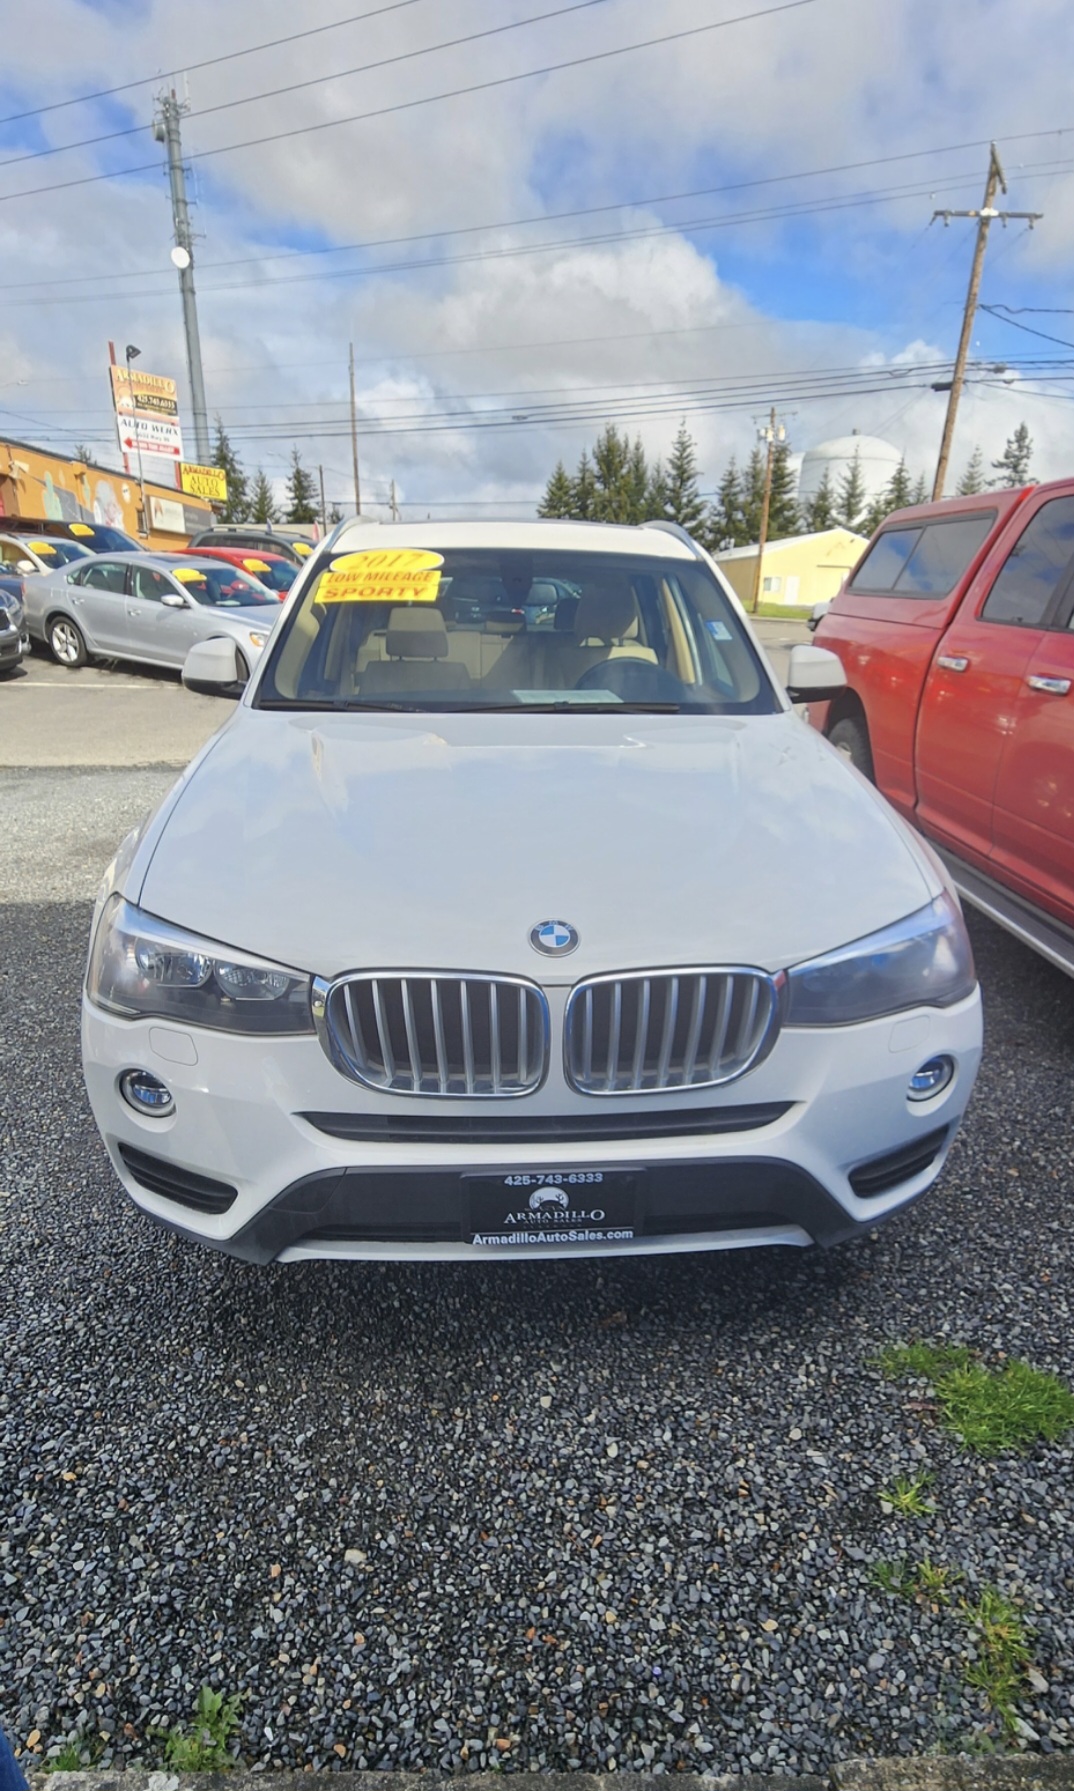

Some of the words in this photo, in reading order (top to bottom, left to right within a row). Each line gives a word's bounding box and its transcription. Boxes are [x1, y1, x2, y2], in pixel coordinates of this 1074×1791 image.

[182, 464, 225, 481] ARMADILLO
[190, 475, 218, 489] AUTO
[190, 484, 221, 498] SALES
[346, 553, 427, 570] 2017
[326, 571, 361, 583] LOW
[364, 570, 433, 583] MILEAGE
[322, 585, 428, 599] SPORTY
[504, 1173, 603, 1186] 425-743-6333
[504, 1209, 605, 1224] ARMADILLO
[472, 1230, 633, 1245] ArmadilloAutoSales.com
